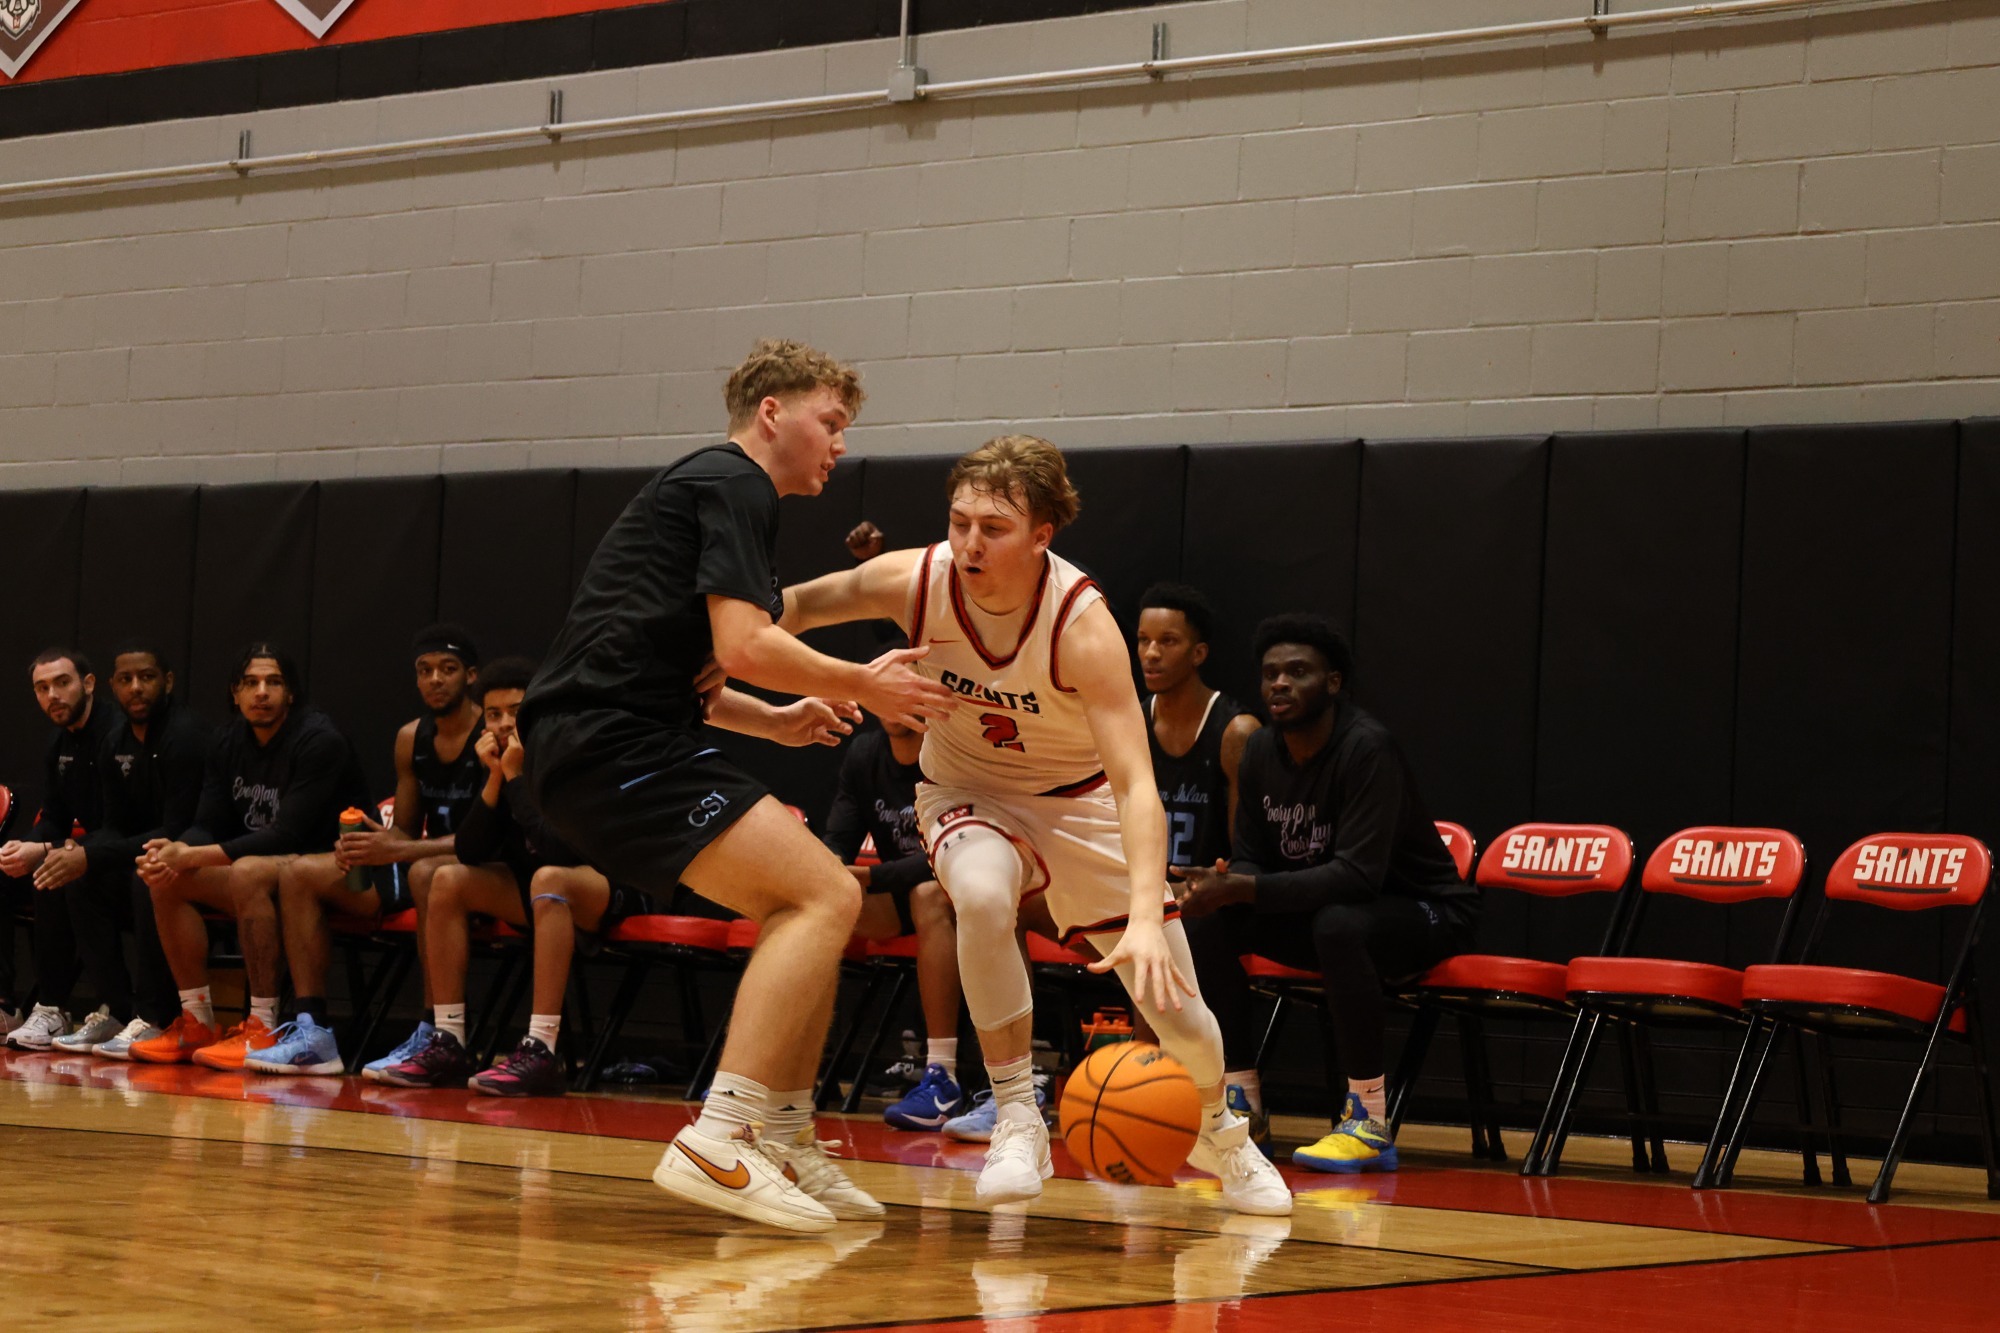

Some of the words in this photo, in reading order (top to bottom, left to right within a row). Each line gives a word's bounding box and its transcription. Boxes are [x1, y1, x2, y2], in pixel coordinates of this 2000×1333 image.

[979, 713, 1026, 753] 2
[688, 790, 730, 827] CSI
[1172, 784, 1209, 803] Islan
[1167, 811, 1195, 865] 2
